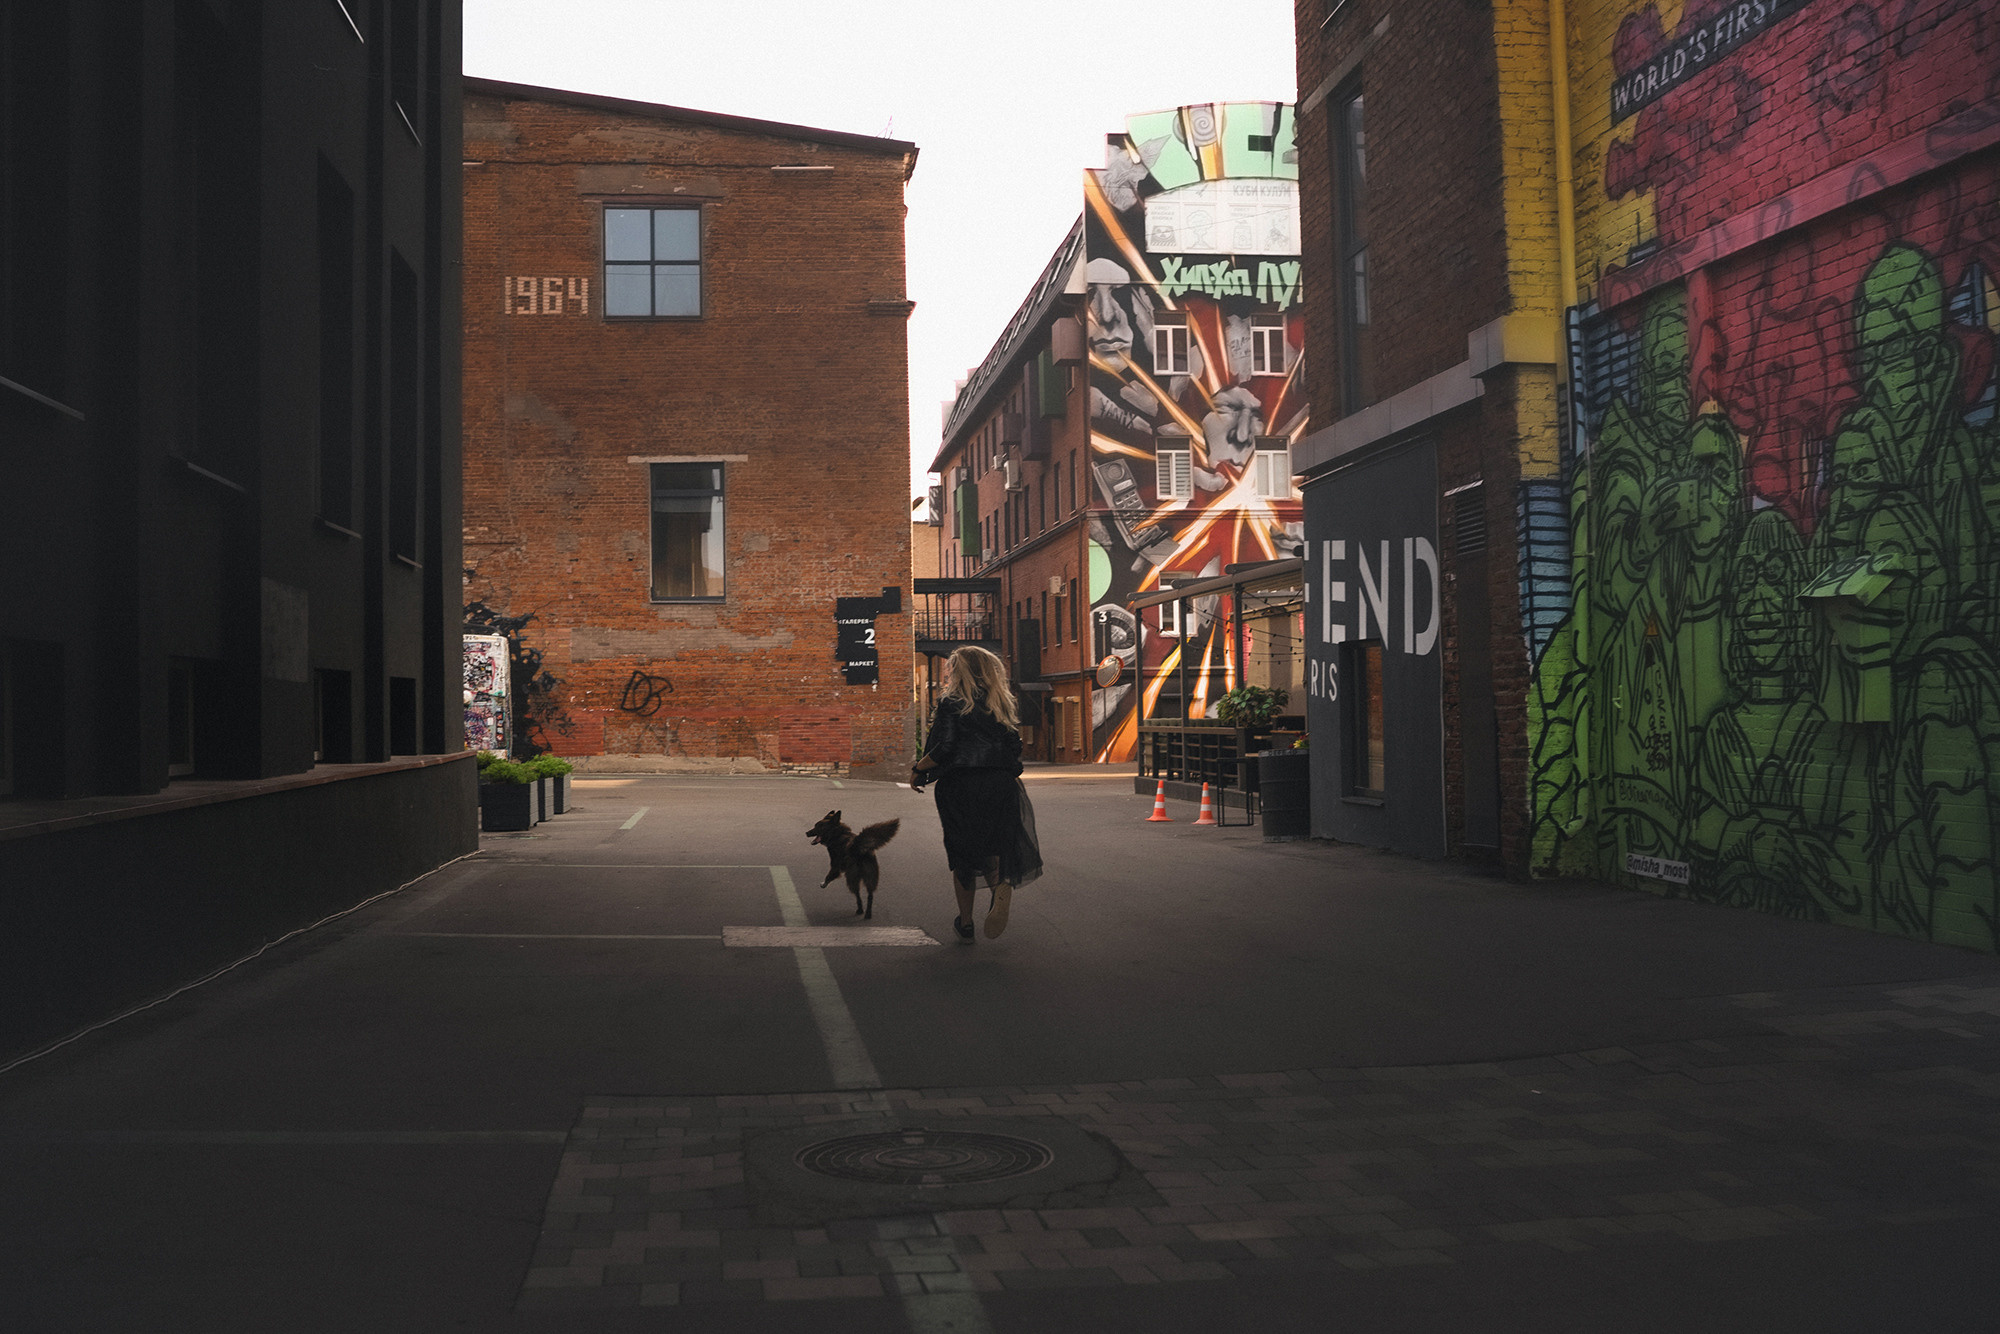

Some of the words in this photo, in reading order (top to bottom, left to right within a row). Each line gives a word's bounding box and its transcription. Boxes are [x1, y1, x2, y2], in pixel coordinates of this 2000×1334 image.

[1614, 28, 1708, 112] WORLD'S
[505, 276, 588, 315] 1964
[1098, 611, 1108, 623] 3
[864, 628, 875, 645] 2
[1626, 854, 1689, 879] @misha_most
